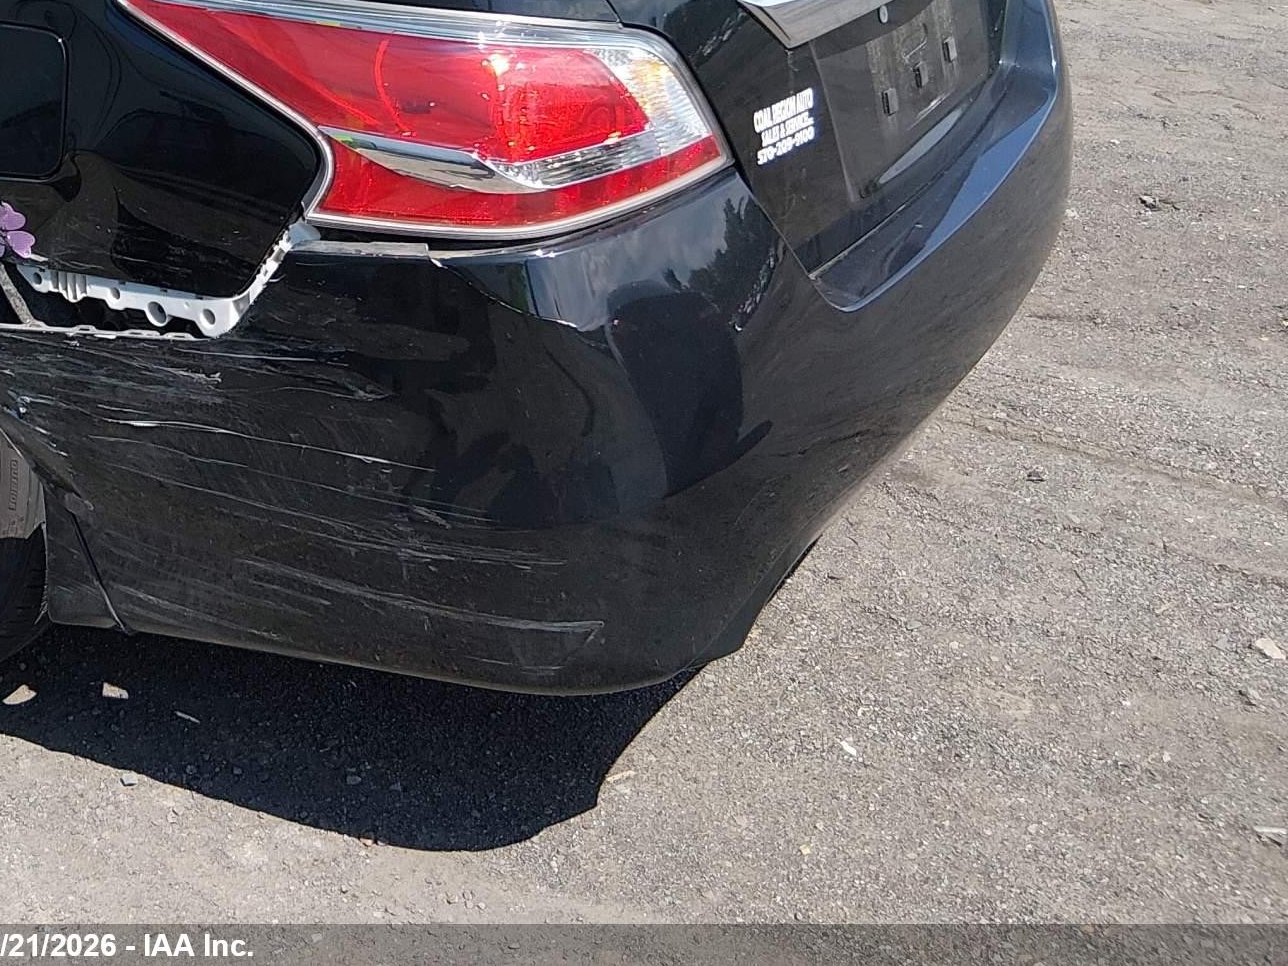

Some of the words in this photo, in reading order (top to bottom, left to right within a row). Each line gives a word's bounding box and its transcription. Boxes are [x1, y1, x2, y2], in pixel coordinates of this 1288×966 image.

[753, 107, 773, 133] COAL
[772, 95, 796, 123] REGION
[796, 87, 814, 115] AUTO
[761, 125, 780, 147] SALES
[779, 122, 788, 139] &
[786, 111, 809, 137] SERVICE
